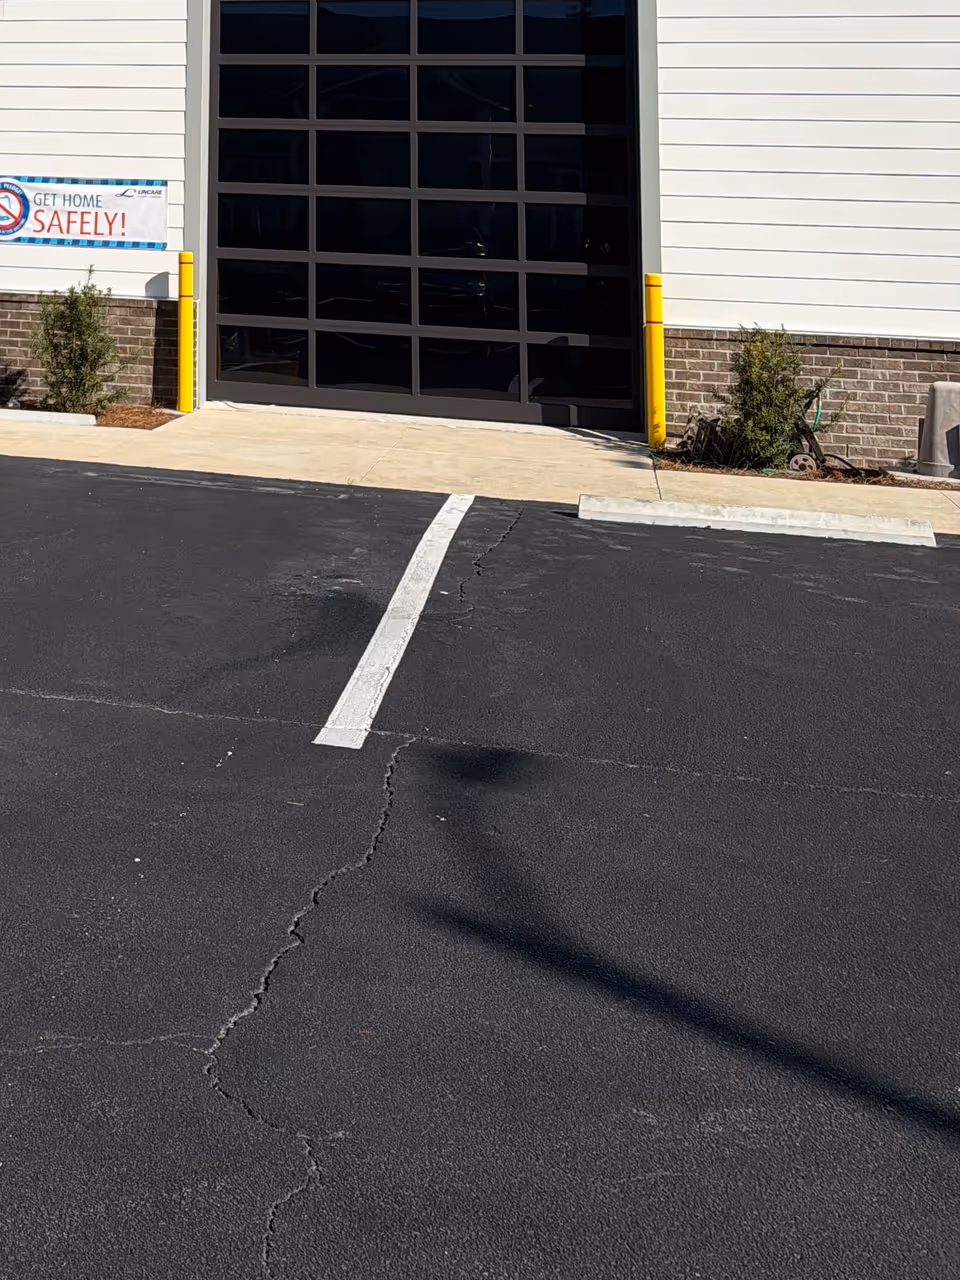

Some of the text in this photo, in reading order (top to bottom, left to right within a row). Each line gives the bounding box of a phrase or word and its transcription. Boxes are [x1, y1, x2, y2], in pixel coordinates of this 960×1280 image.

[33, 192, 103, 208] GET HOME
[33, 209, 126, 236] SAFELY!
